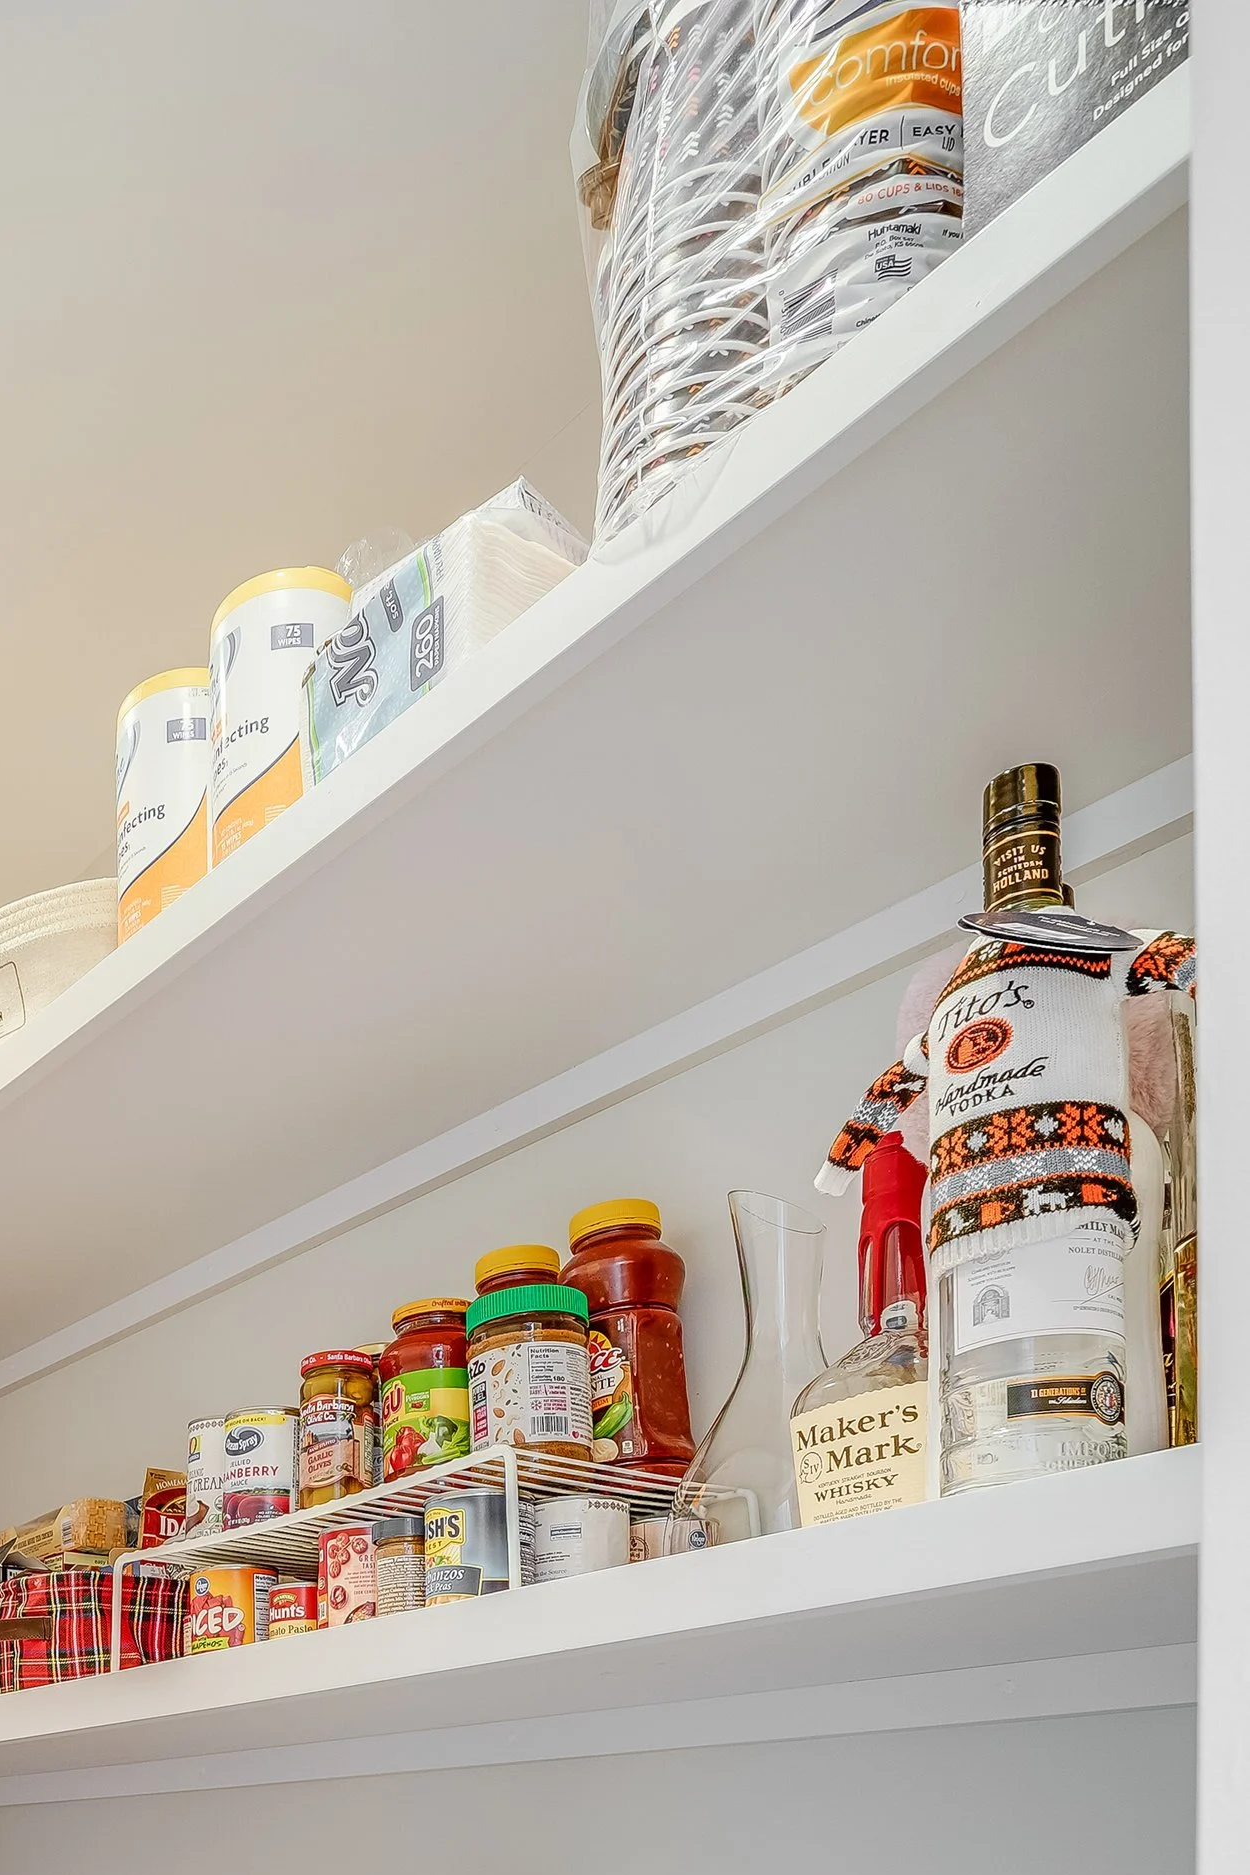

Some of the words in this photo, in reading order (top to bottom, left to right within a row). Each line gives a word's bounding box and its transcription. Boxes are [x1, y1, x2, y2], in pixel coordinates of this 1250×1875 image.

[1111, 57, 1138, 87] Full
[1141, 28, 1173, 61] Size
[1093, 53, 1163, 122] Designed
[912, 124, 957, 138] EASY
[941, 136, 956, 153] LID
[877, 183, 910, 200] CUPS
[925, 182, 950, 193] LIDS
[285, 625, 301, 637] 75
[278, 637, 301, 646] WIPES
[414, 614, 435, 678] 260
[993, 845, 1025, 867] VISIT
[1031, 844, 1046, 855] US
[993, 868, 1049, 893] HOLLAND
[937, 980, 1029, 1042] Tito's
[935, 1056, 1049, 1116] Handmade
[949, 1084, 1014, 1116] VODKA
[317, 1401, 355, 1412] Barbara
[796, 1405, 919, 1452] Maker's
[239, 1434, 258, 1452] Spray
[230, 1458, 251, 1468] JELLIED
[308, 1450, 333, 1465] GARLIC
[826, 1434, 920, 1474] Mark
[308, 1460, 332, 1474] OLIVES
[866, 1467, 892, 1478] BOURBON
[230, 1479, 248, 1488] SAUCE
[814, 1473, 899, 1502] WHISKY
